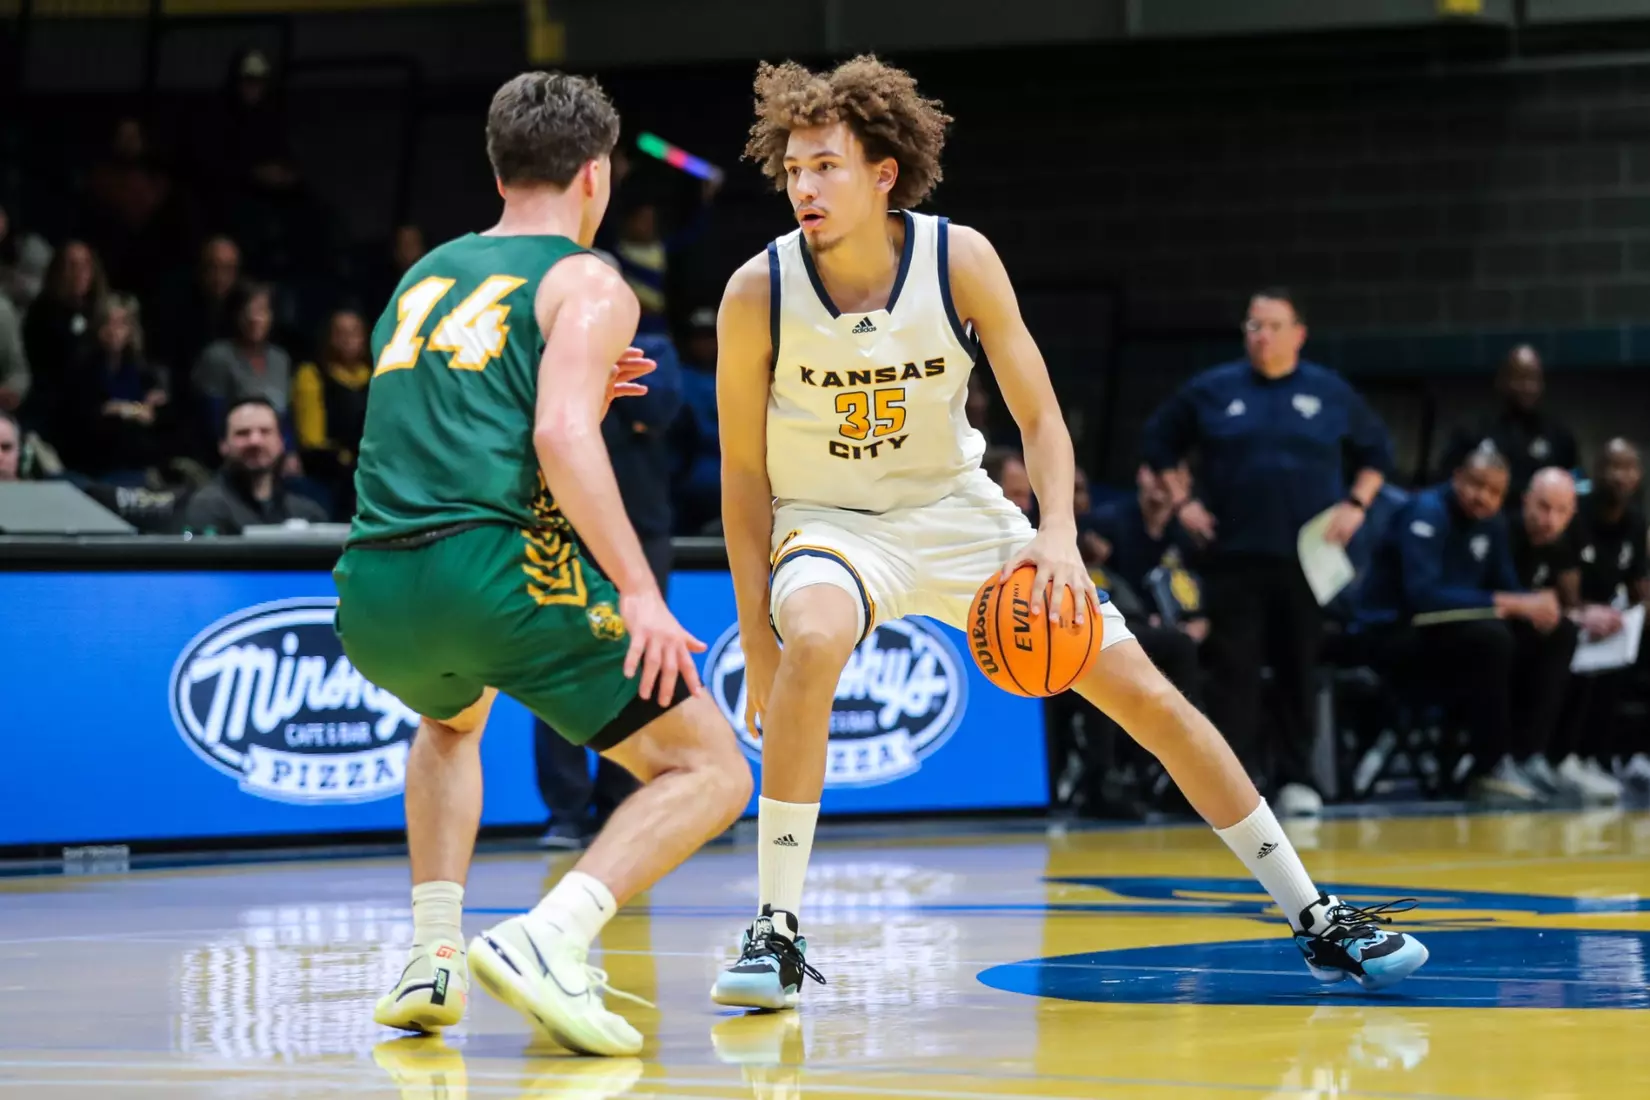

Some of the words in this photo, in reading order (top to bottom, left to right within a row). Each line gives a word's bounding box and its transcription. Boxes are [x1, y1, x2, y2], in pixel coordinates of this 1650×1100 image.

[373, 274, 528, 378] 14
[852, 326, 877, 334] adidas
[799, 357, 945, 387] KANSAS
[835, 388, 907, 440] 35
[829, 434, 909, 460] CITY
[1013, 599, 1033, 652] EVO
[272, 757, 395, 789] PIZZA
